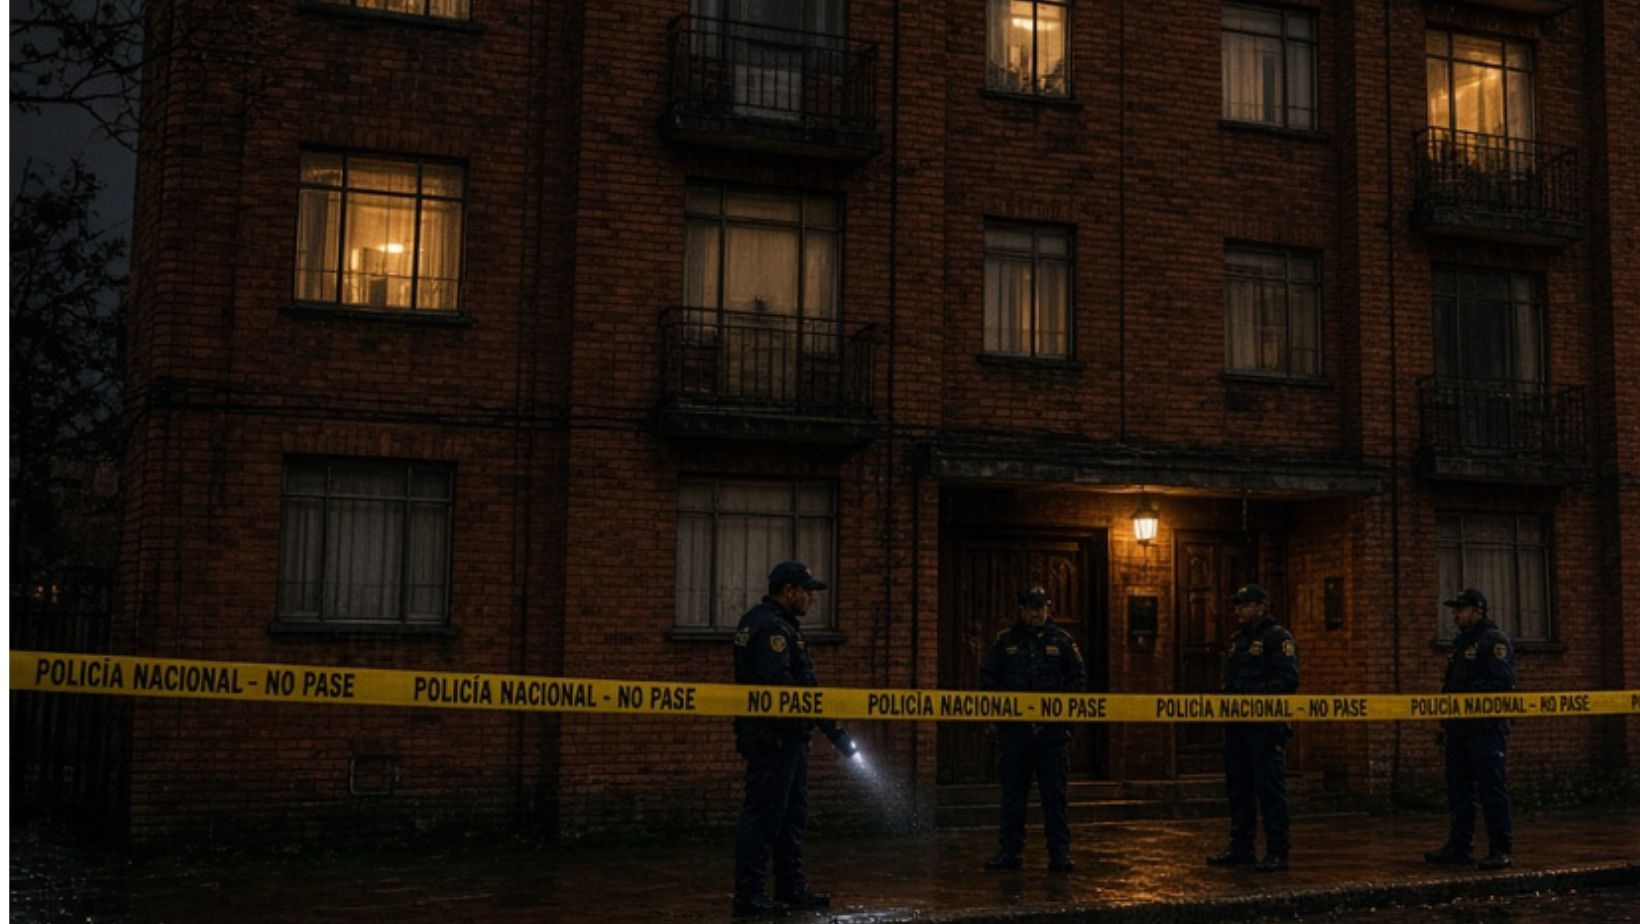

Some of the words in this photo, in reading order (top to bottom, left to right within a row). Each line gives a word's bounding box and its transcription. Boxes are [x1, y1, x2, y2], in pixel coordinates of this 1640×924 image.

[36, 658, 124, 688] POLICÍA
[132, 662, 243, 694] NACIONAL
[264, 669, 296, 696] NO
[302, 672, 356, 698] PASE
[413, 675, 492, 704] POLICÍA
[500, 680, 598, 708] NACIONAL
[617, 686, 643, 710] NO
[649, 687, 697, 711] PASE
[746, 690, 773, 713] NO
[779, 691, 824, 714] PASE
[867, 691, 934, 716] POLICÍA
[940, 694, 1023, 717] NACIONAL
[1041, 697, 1063, 718] NO
[1068, 697, 1107, 718] PASE
[1560, 694, 1591, 712] PASE
[1156, 695, 1215, 718] POLICÍA
[1219, 698, 1294, 718] NACIONAL
[1308, 698, 1328, 717] NO
[1333, 698, 1368, 717] PASE
